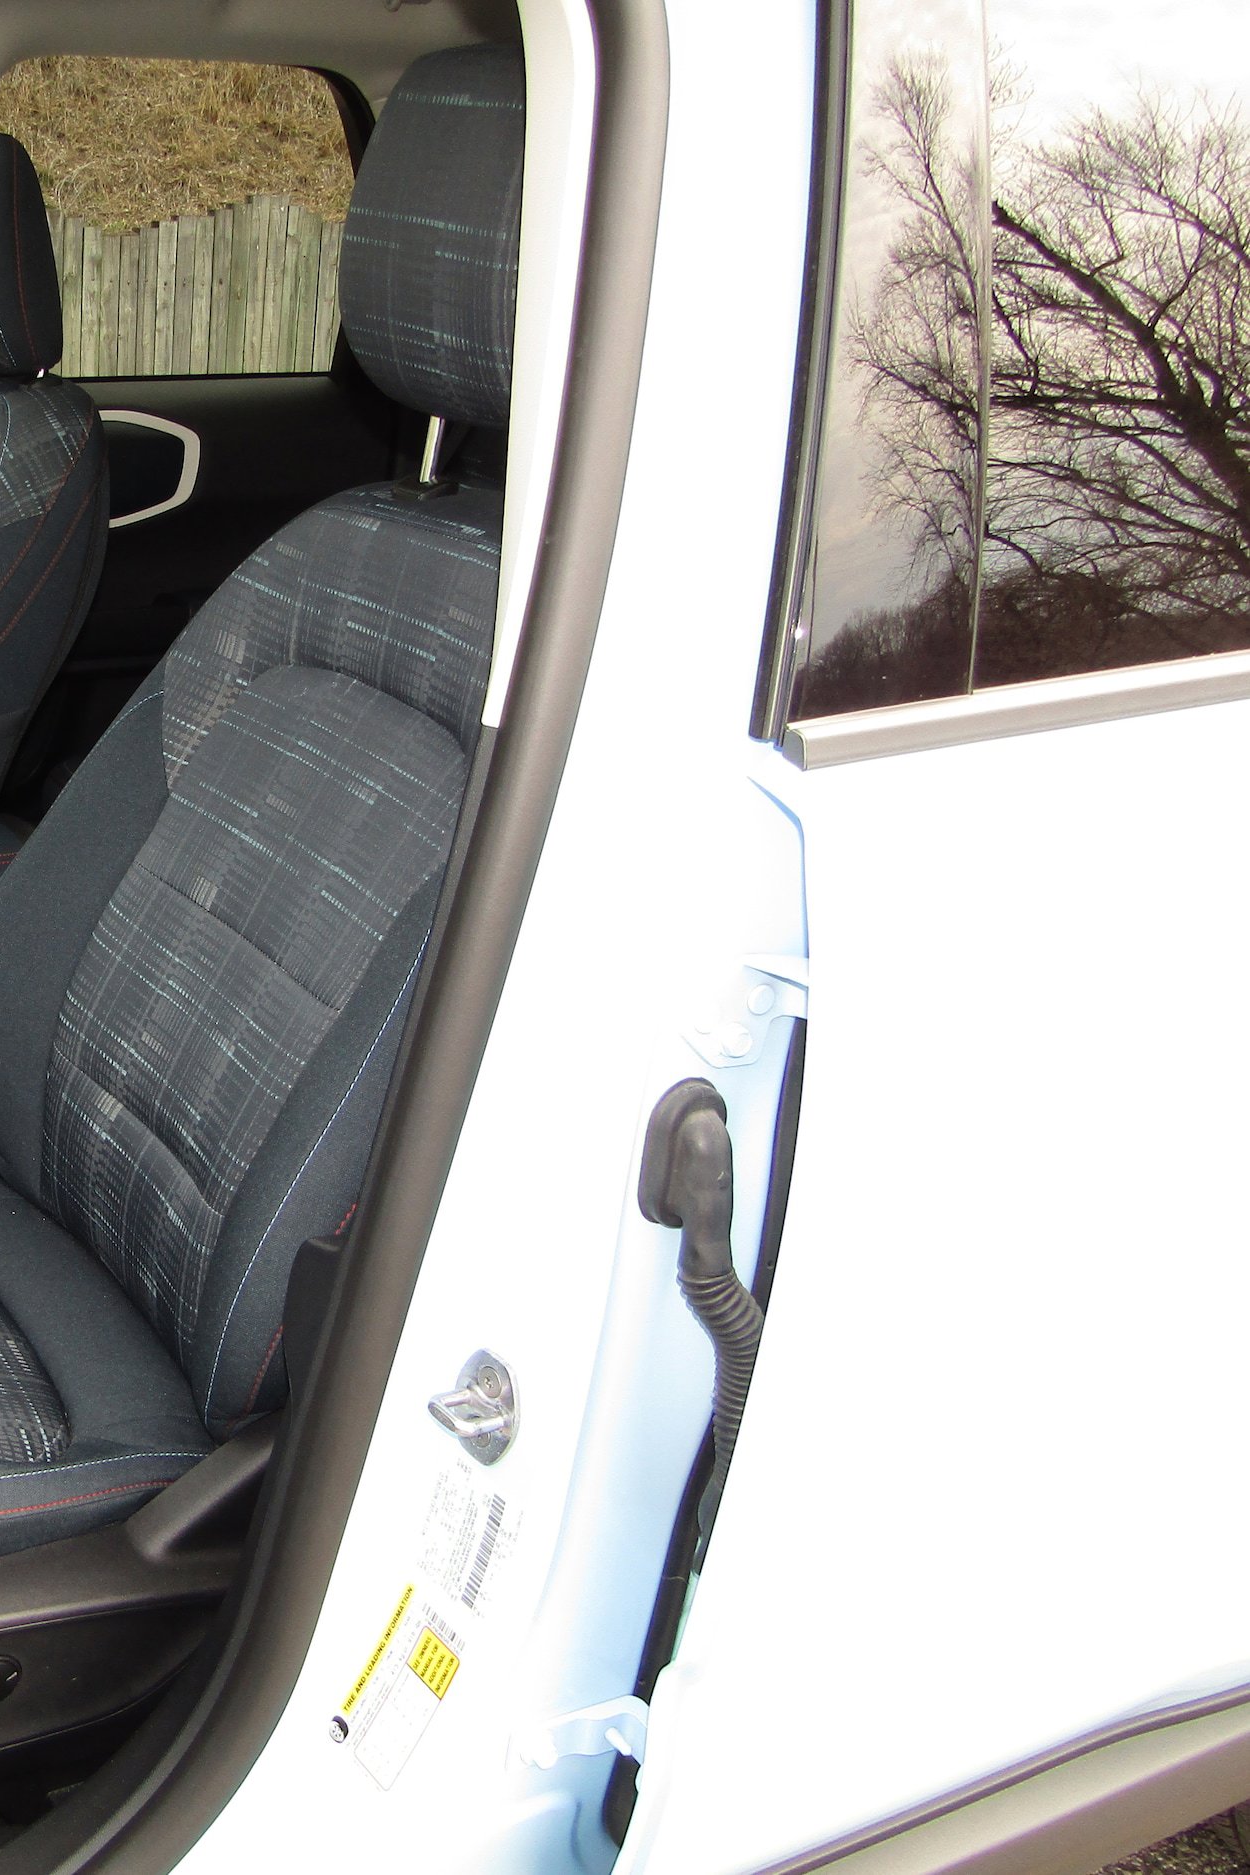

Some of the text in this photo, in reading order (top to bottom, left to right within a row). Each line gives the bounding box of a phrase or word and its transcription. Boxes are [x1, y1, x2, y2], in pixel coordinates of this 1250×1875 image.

[344, 1695, 356, 1712] TIRE
[355, 1675, 367, 1694] AND
[364, 1641, 386, 1677] LOADING
[383, 1586, 413, 1641] INFORMATION
